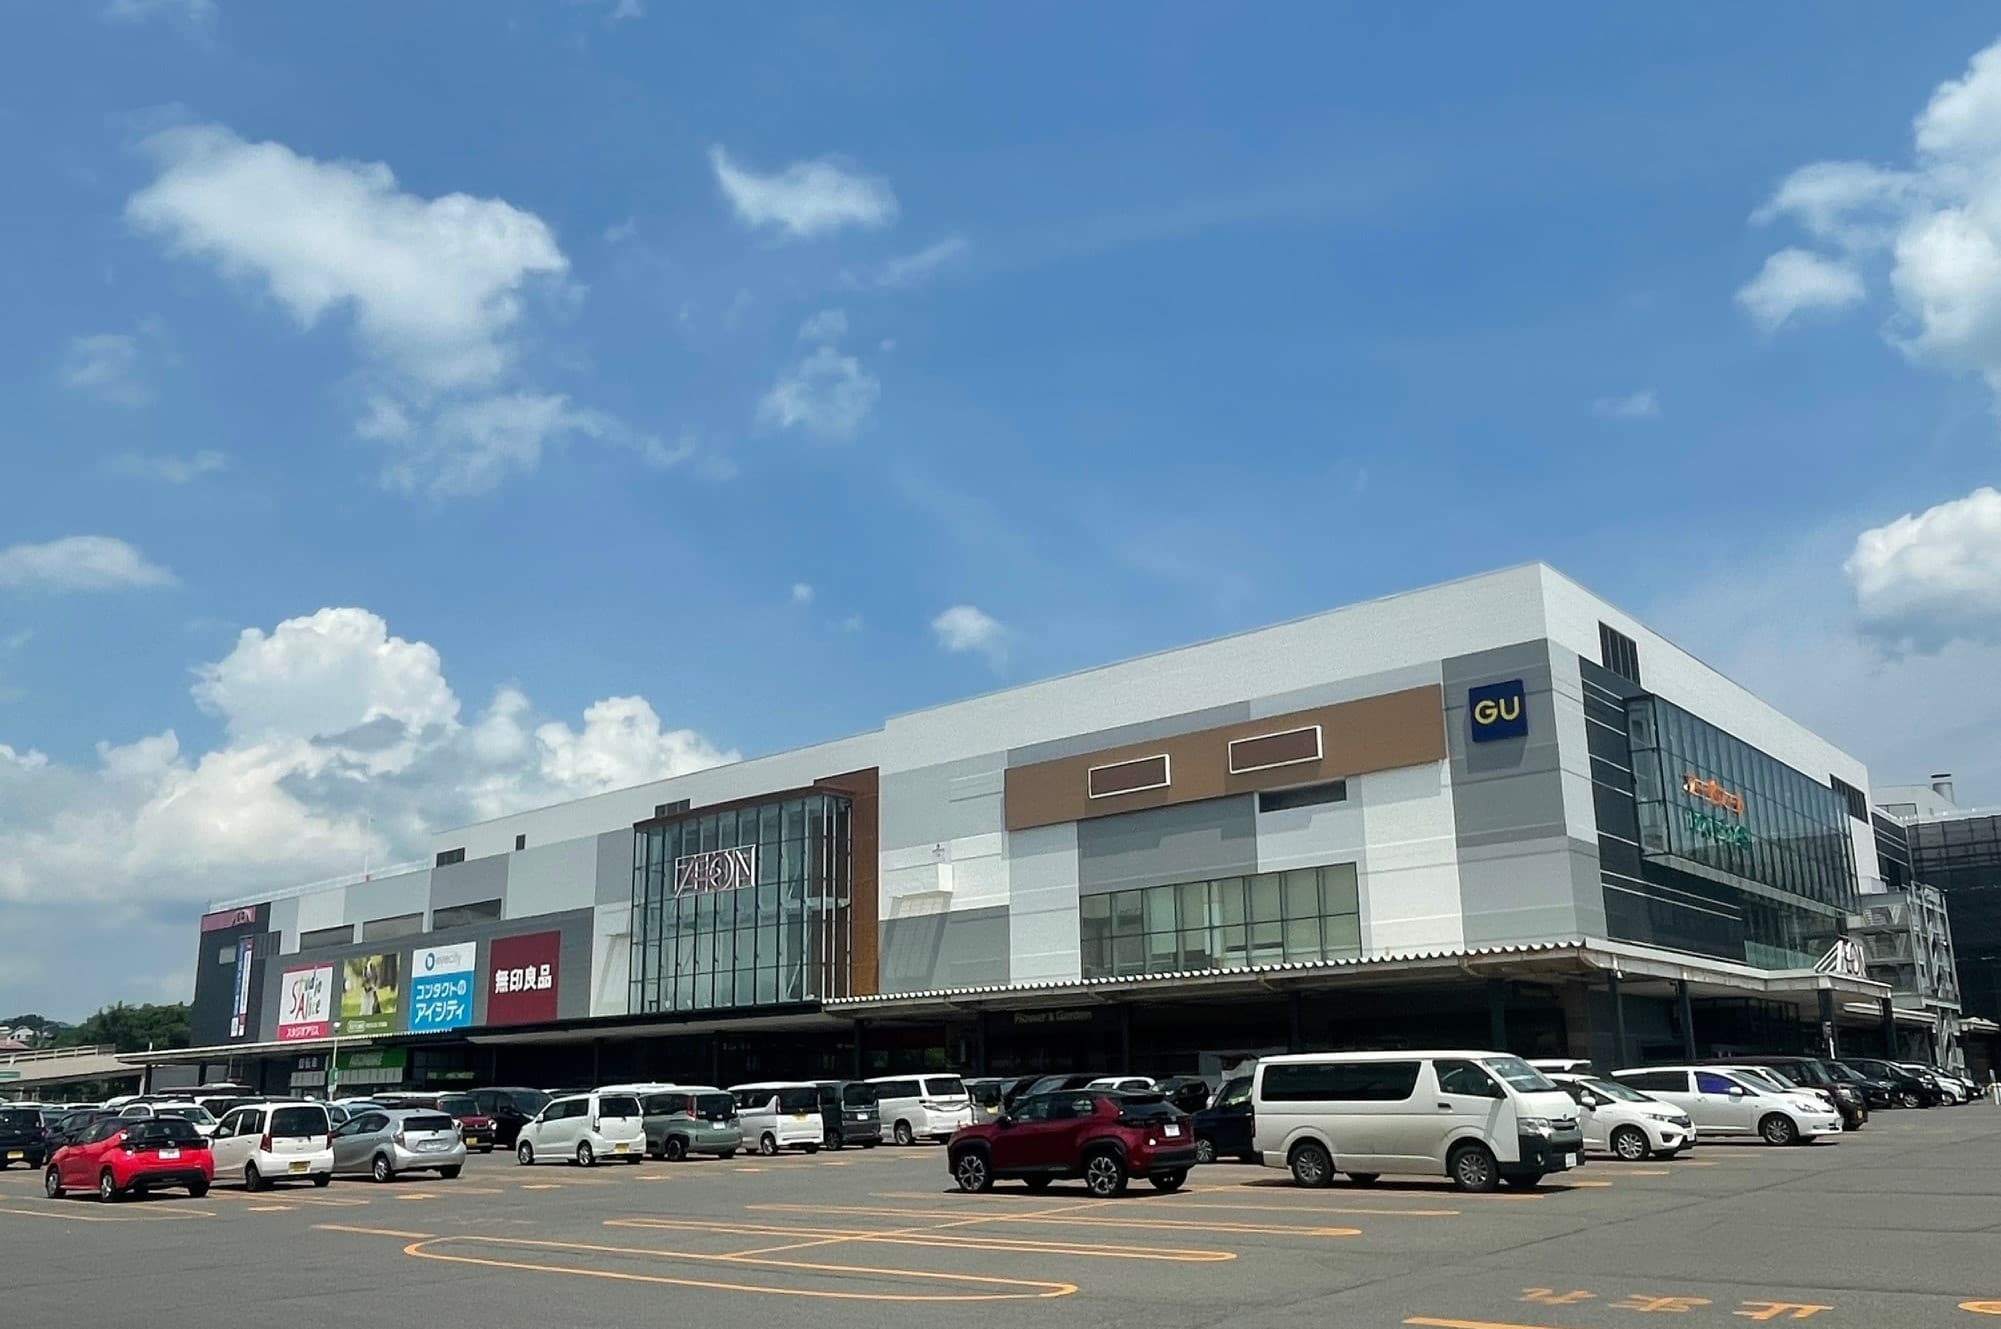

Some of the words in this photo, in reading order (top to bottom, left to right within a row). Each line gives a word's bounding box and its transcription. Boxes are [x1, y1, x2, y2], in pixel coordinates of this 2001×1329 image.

[1474, 695, 1520, 725] GU
[494, 963, 553, 994] 無印良品
[414, 999, 466, 1025] アイシティ
